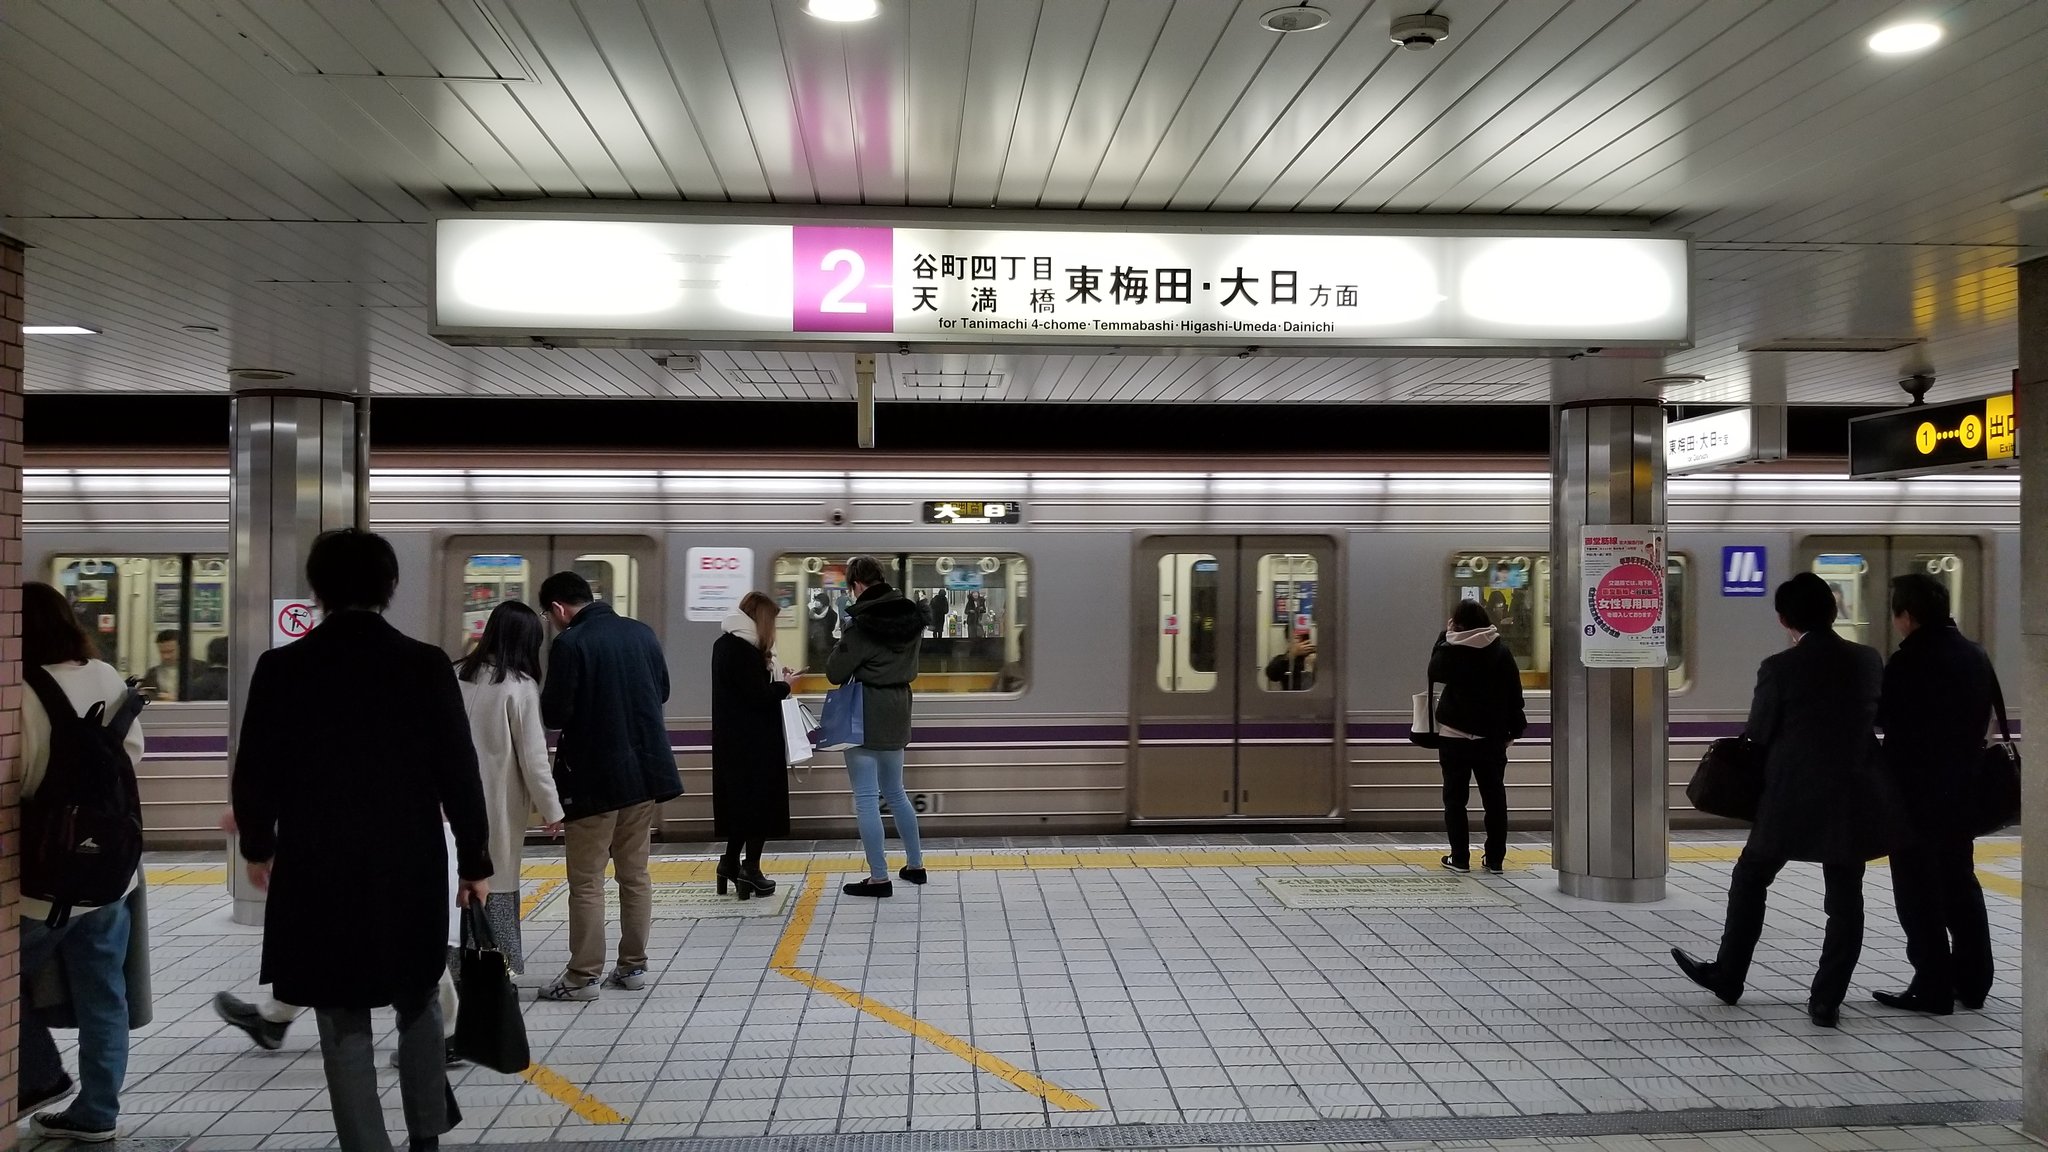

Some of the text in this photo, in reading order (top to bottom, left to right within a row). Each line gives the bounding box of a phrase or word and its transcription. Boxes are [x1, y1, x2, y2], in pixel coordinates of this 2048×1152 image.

[912, 253, 1052, 281] 谷町四丁目
[819, 249, 869, 314] 2
[938, 317, 957, 329] for
[961, 317, 1028, 330] Tanimachi
[1922, 423, 1975, 446] 1 8
[700, 556, 739, 571] ECC
[1598, 598, 1659, 610] 女性専用車両
